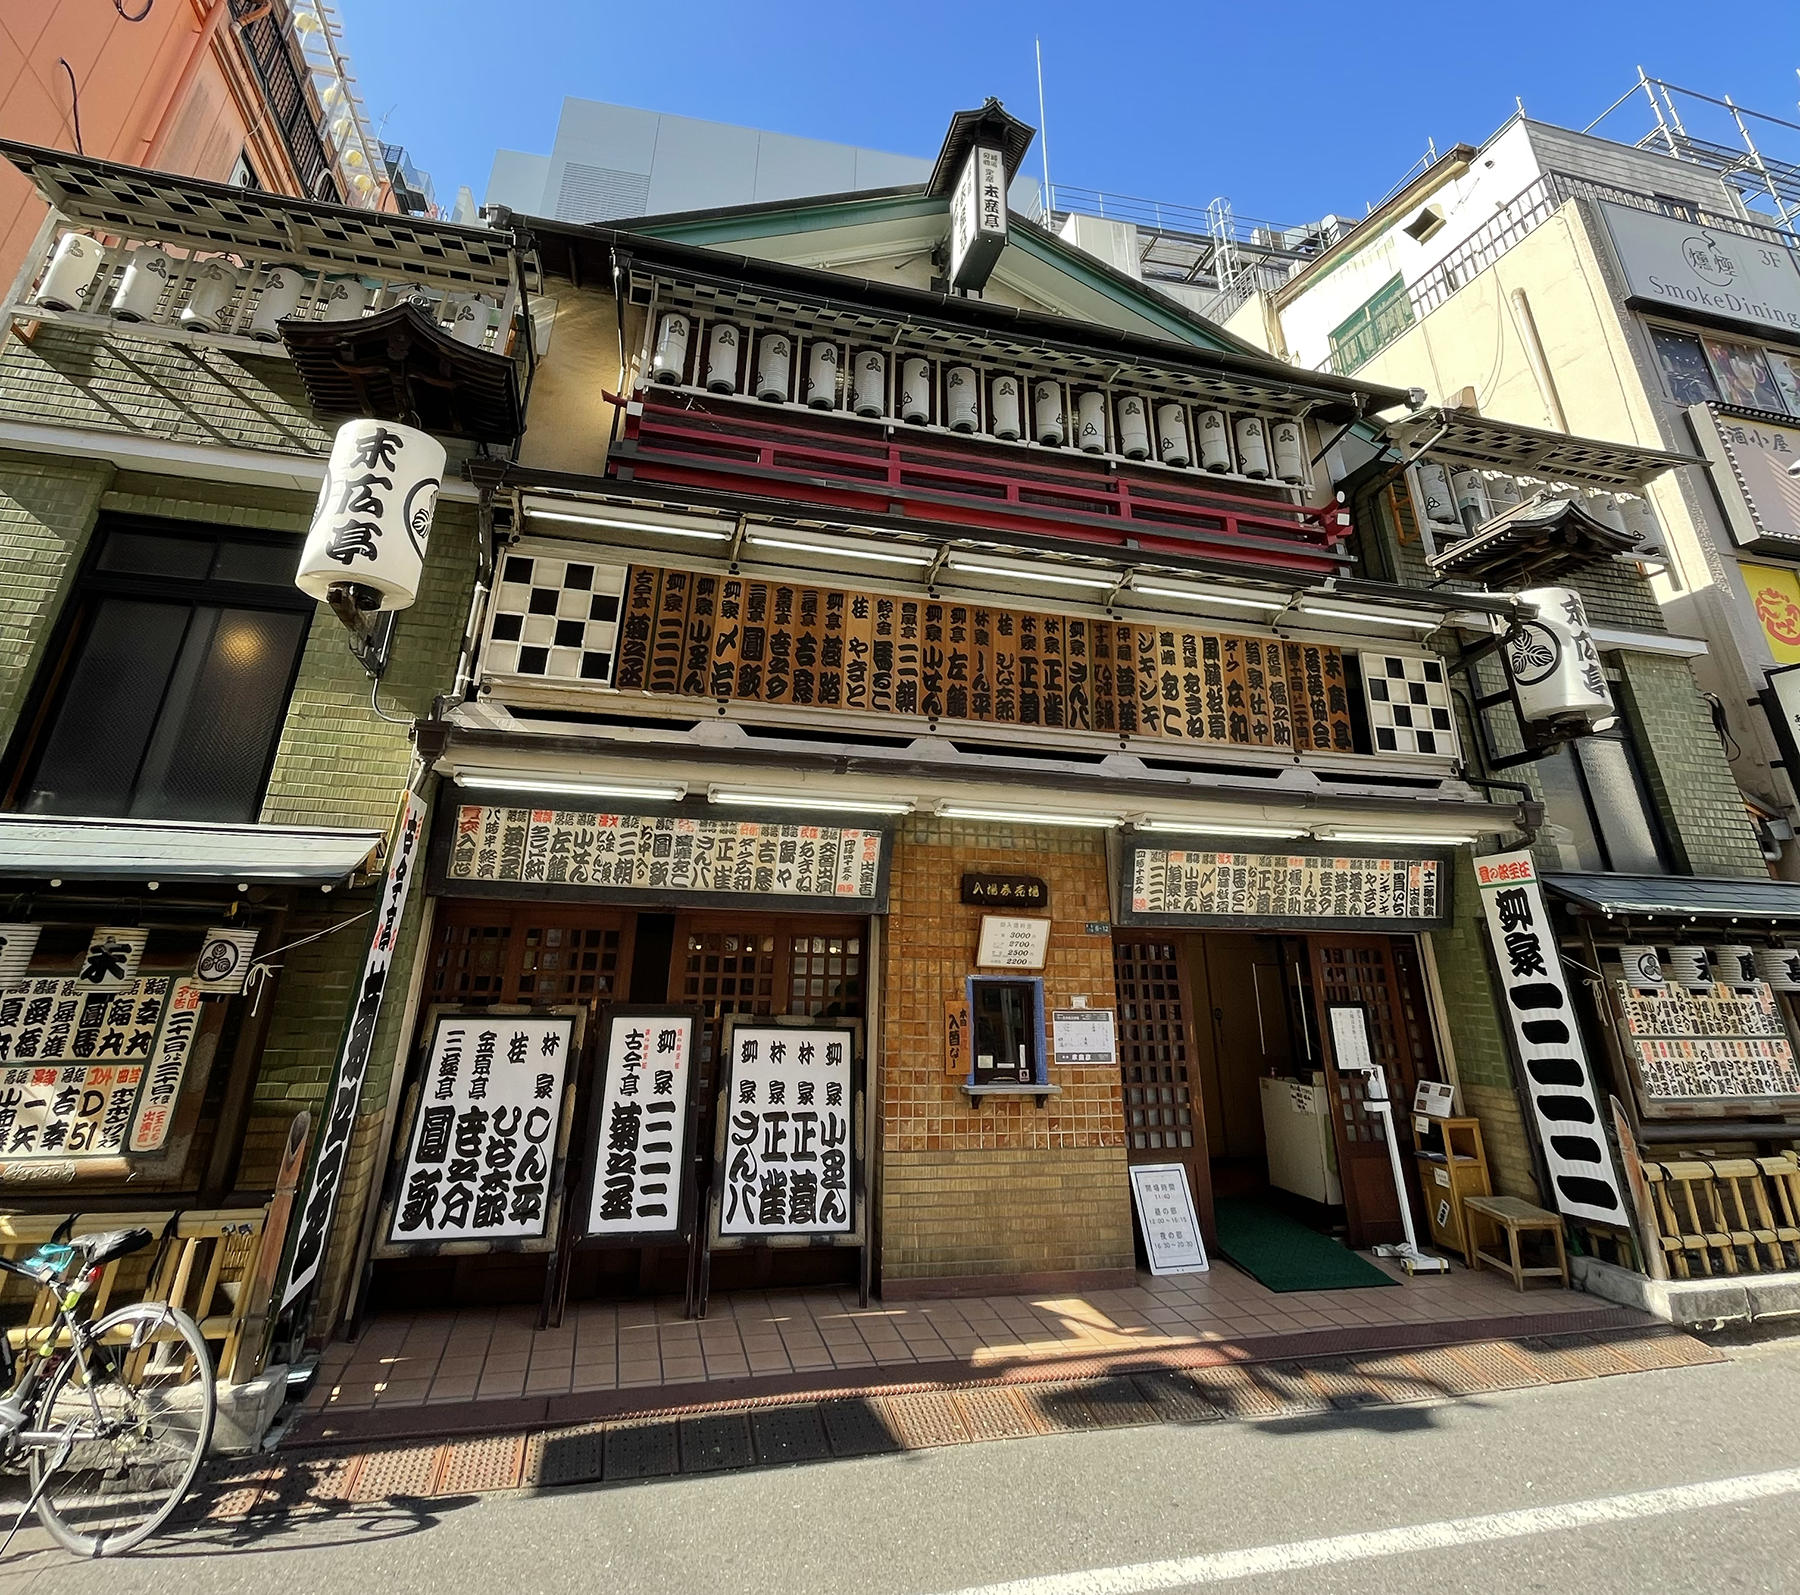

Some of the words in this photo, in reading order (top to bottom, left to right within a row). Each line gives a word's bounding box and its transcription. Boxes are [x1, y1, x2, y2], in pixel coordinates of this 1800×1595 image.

[1649, 276, 1799, 329] SmokeDining
[1758, 249, 1781, 269] 3F
[1726, 426, 1792, 453] 酒小屋
[326, 428, 404, 565] 末広亭
[618, 569, 654, 688] 古今亭菊之丞
[650, 572, 687, 691] 柳家三三
[683, 577, 715, 694] 柳家小里ん
[737, 584, 768, 699] 三遊亭圓歌
[846, 595, 869, 708] 桂やまと
[895, 602, 918, 714] 春風亭三朝
[922, 604, 944, 716] 柳家小せん
[1068, 621, 1090, 730] 柳家さん八
[1138, 632, 1160, 732] ジキジキ
[1324, 649, 1352, 750] 末廣亭
[499, 825, 525, 880] 菊之丞
[569, 829, 594, 883] 小せん
[613, 831, 638, 885] 三朝
[691, 836, 715, 887] さん八
[796, 841, 815, 892] あまね
[1364, 872, 1377, 916] やまと
[1379, 873, 1391, 915] ジキジキ
[71, 1002, 105, 1058] 圓馬
[125, 997, 162, 1057] 幸丸
[1496, 887, 1619, 1211] 柳家三三
[8, 1098, 49, 1153] 一矢
[39, 1085, 81, 1150] 吉幸
[68, 1089, 104, 1150] D51
[398, 1030, 466, 1232] 三遊亭圓歌
[473, 1031, 530, 1228] 桂ひな太郎
[509, 1031, 561, 1225] 林家しん平
[600, 1028, 645, 1221] 古今亭菊之丞
[636, 1029, 676, 1217] 柳家三三
[725, 1039, 760, 1224] 柳家さん八
[759, 1040, 789, 1225] 林家正雀
[789, 1041, 818, 1224] 林家正蔵
[819, 1041, 847, 1224] 柳家小里ん
[1160, 1231, 1184, 1240] 夜の部
